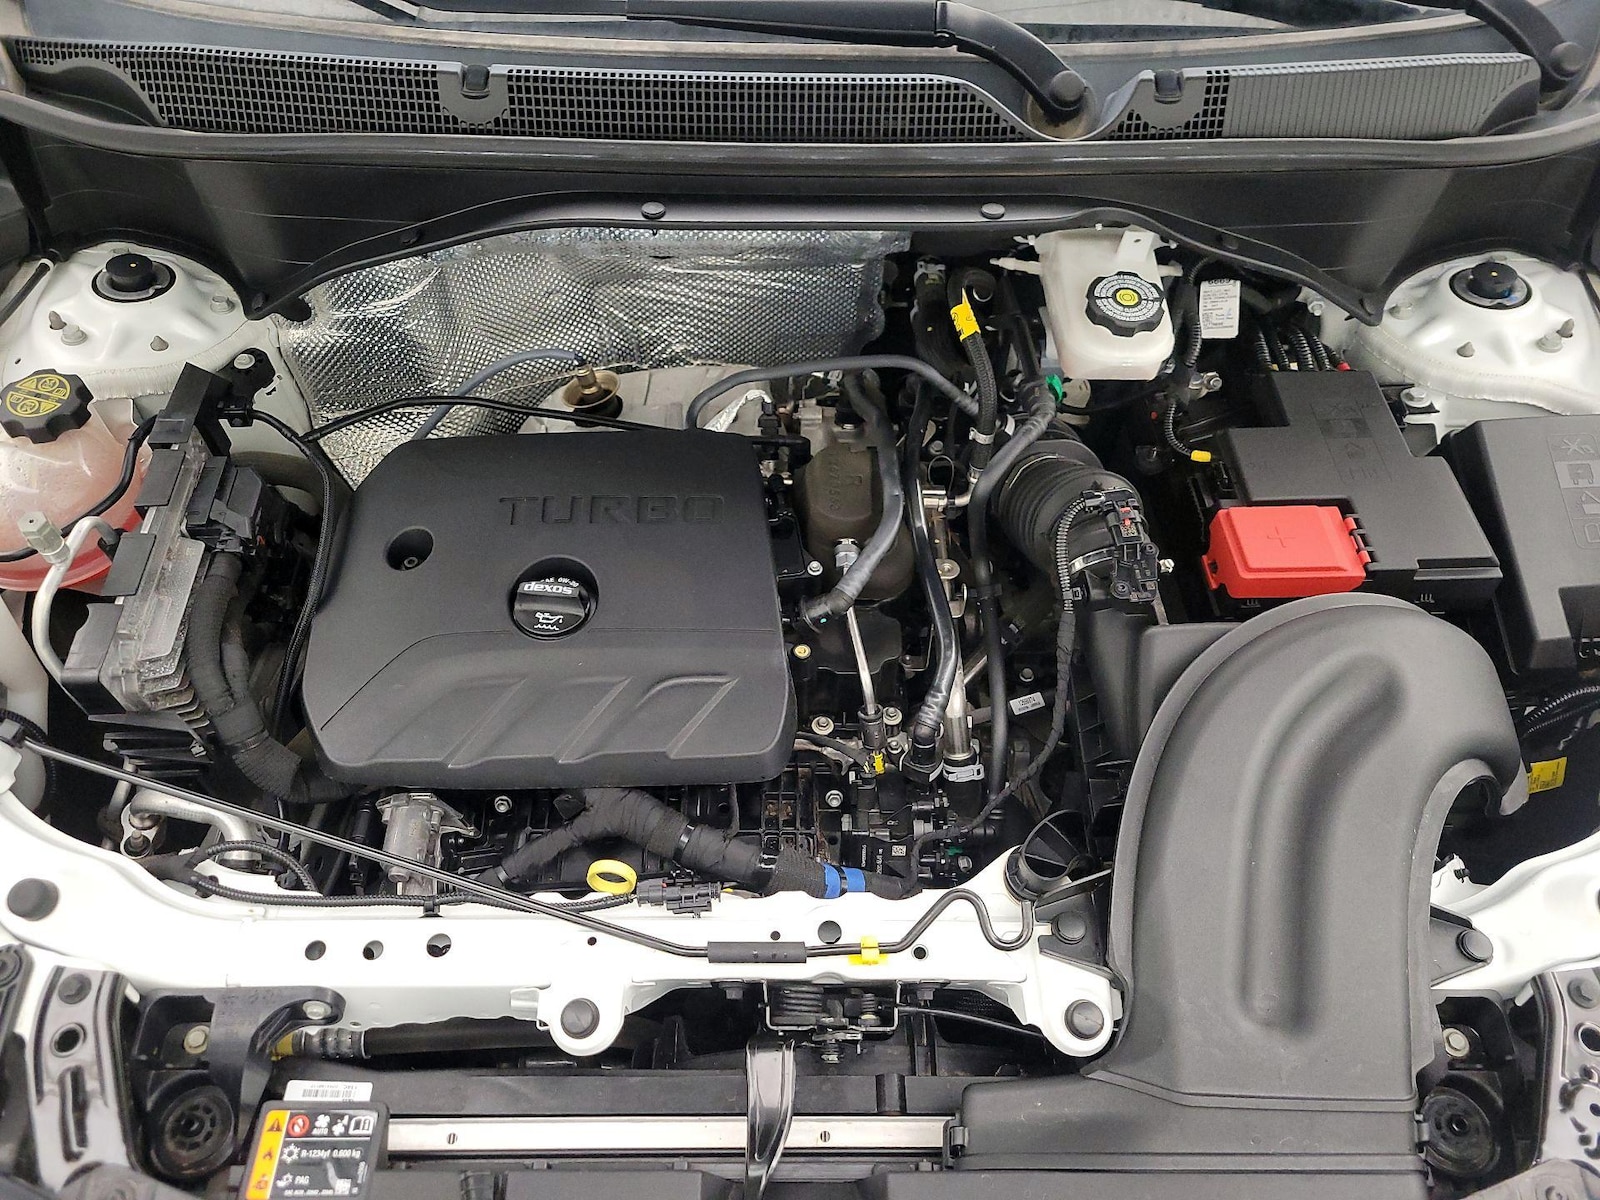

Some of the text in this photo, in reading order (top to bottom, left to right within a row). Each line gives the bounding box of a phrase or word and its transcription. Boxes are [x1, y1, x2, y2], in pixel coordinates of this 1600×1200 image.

[499, 495, 725, 526] TURBO
[524, 582, 575, 595] dexos
[294, 1175, 310, 1185] PAG
